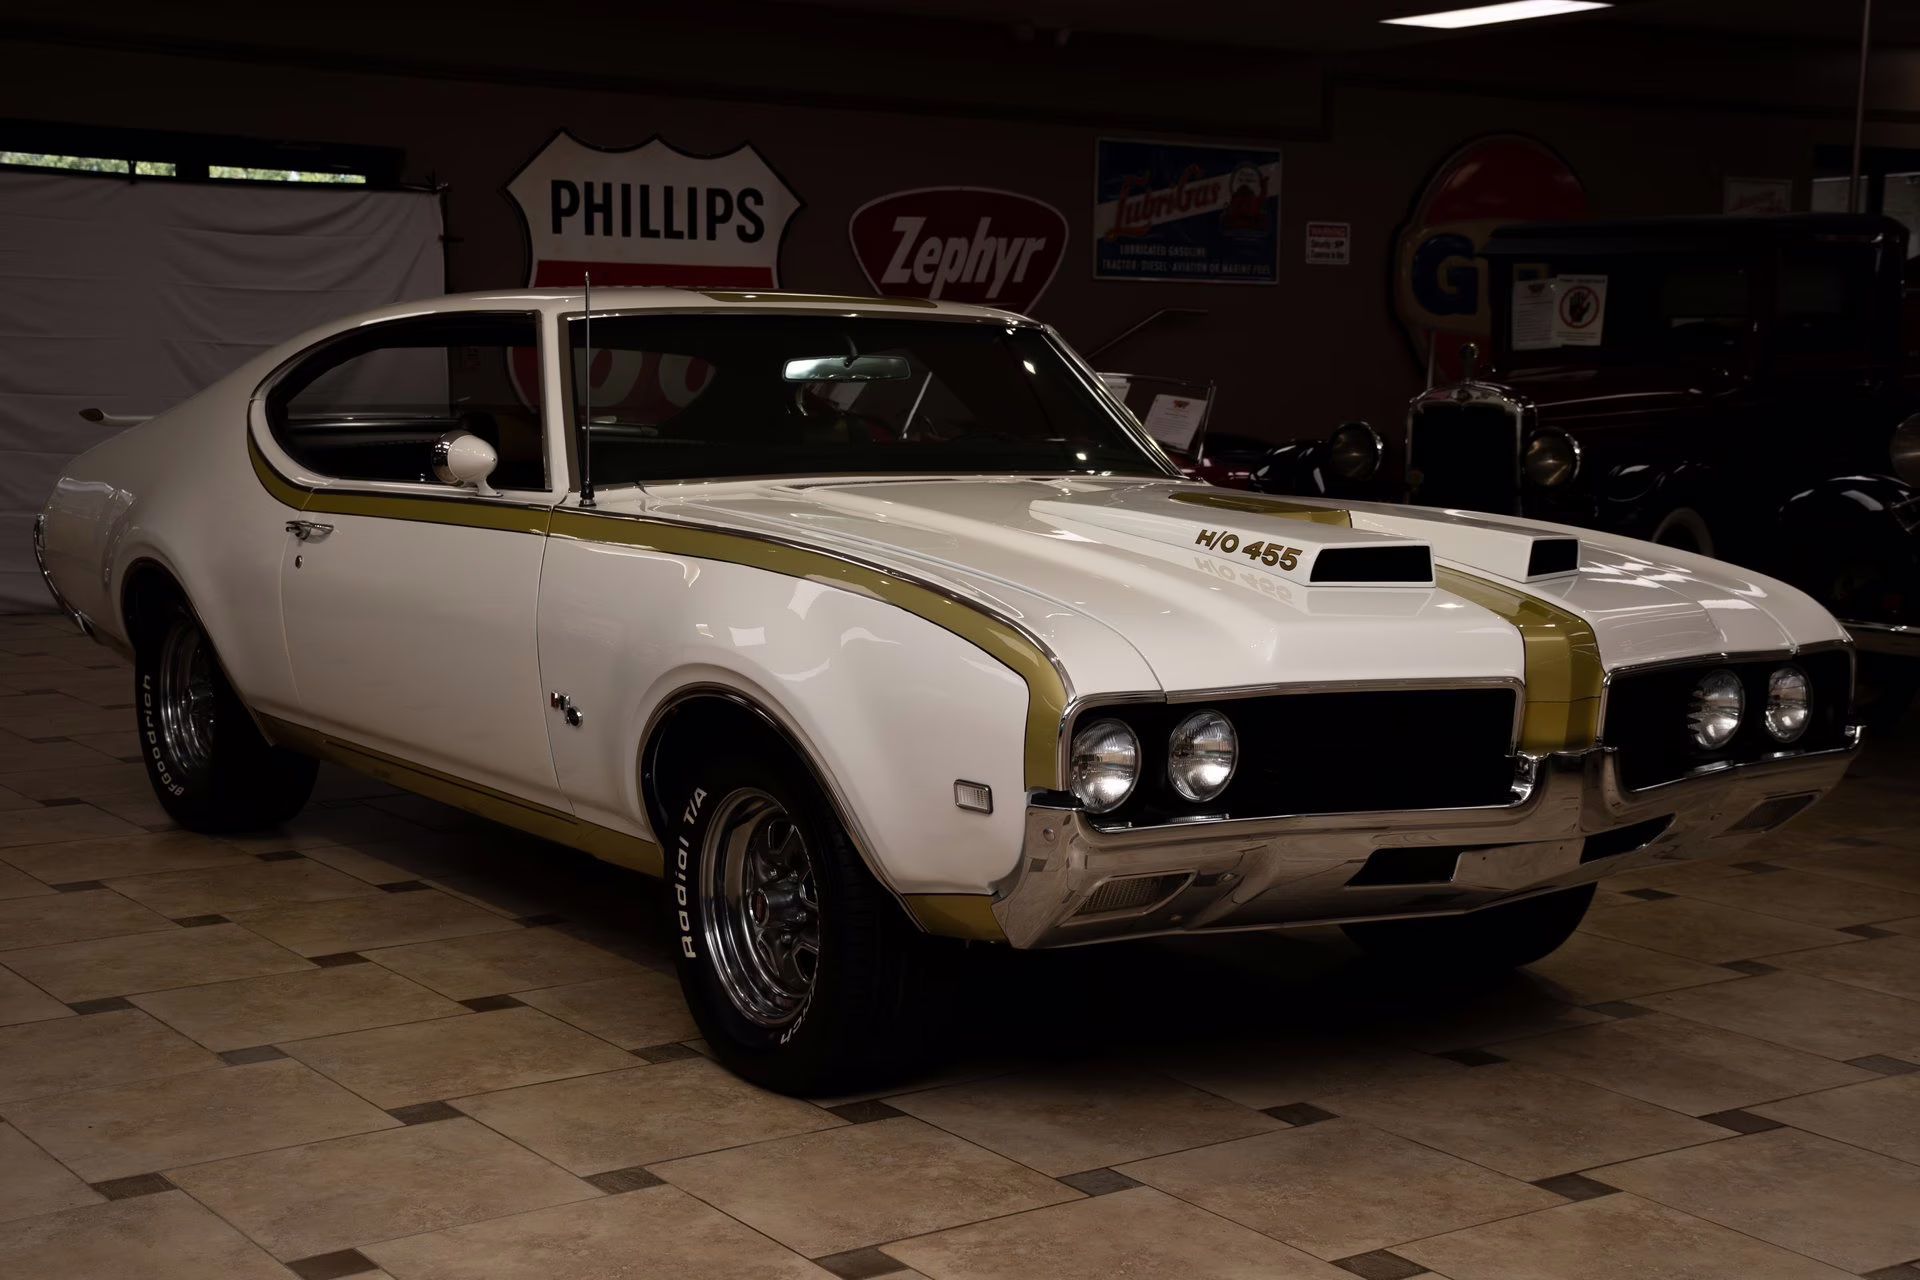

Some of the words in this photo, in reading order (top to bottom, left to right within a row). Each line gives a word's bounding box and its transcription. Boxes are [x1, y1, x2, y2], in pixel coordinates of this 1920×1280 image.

[551, 179, 766, 244] PHILLIPS
[880, 215, 1048, 300] Zephyr
[1195, 529, 1240, 554] H/O
[1241, 541, 1304, 572] 455
[141, 673, 184, 797] BFGoodrich
[682, 786, 708, 826] T/A
[674, 835, 698, 959] Radial
